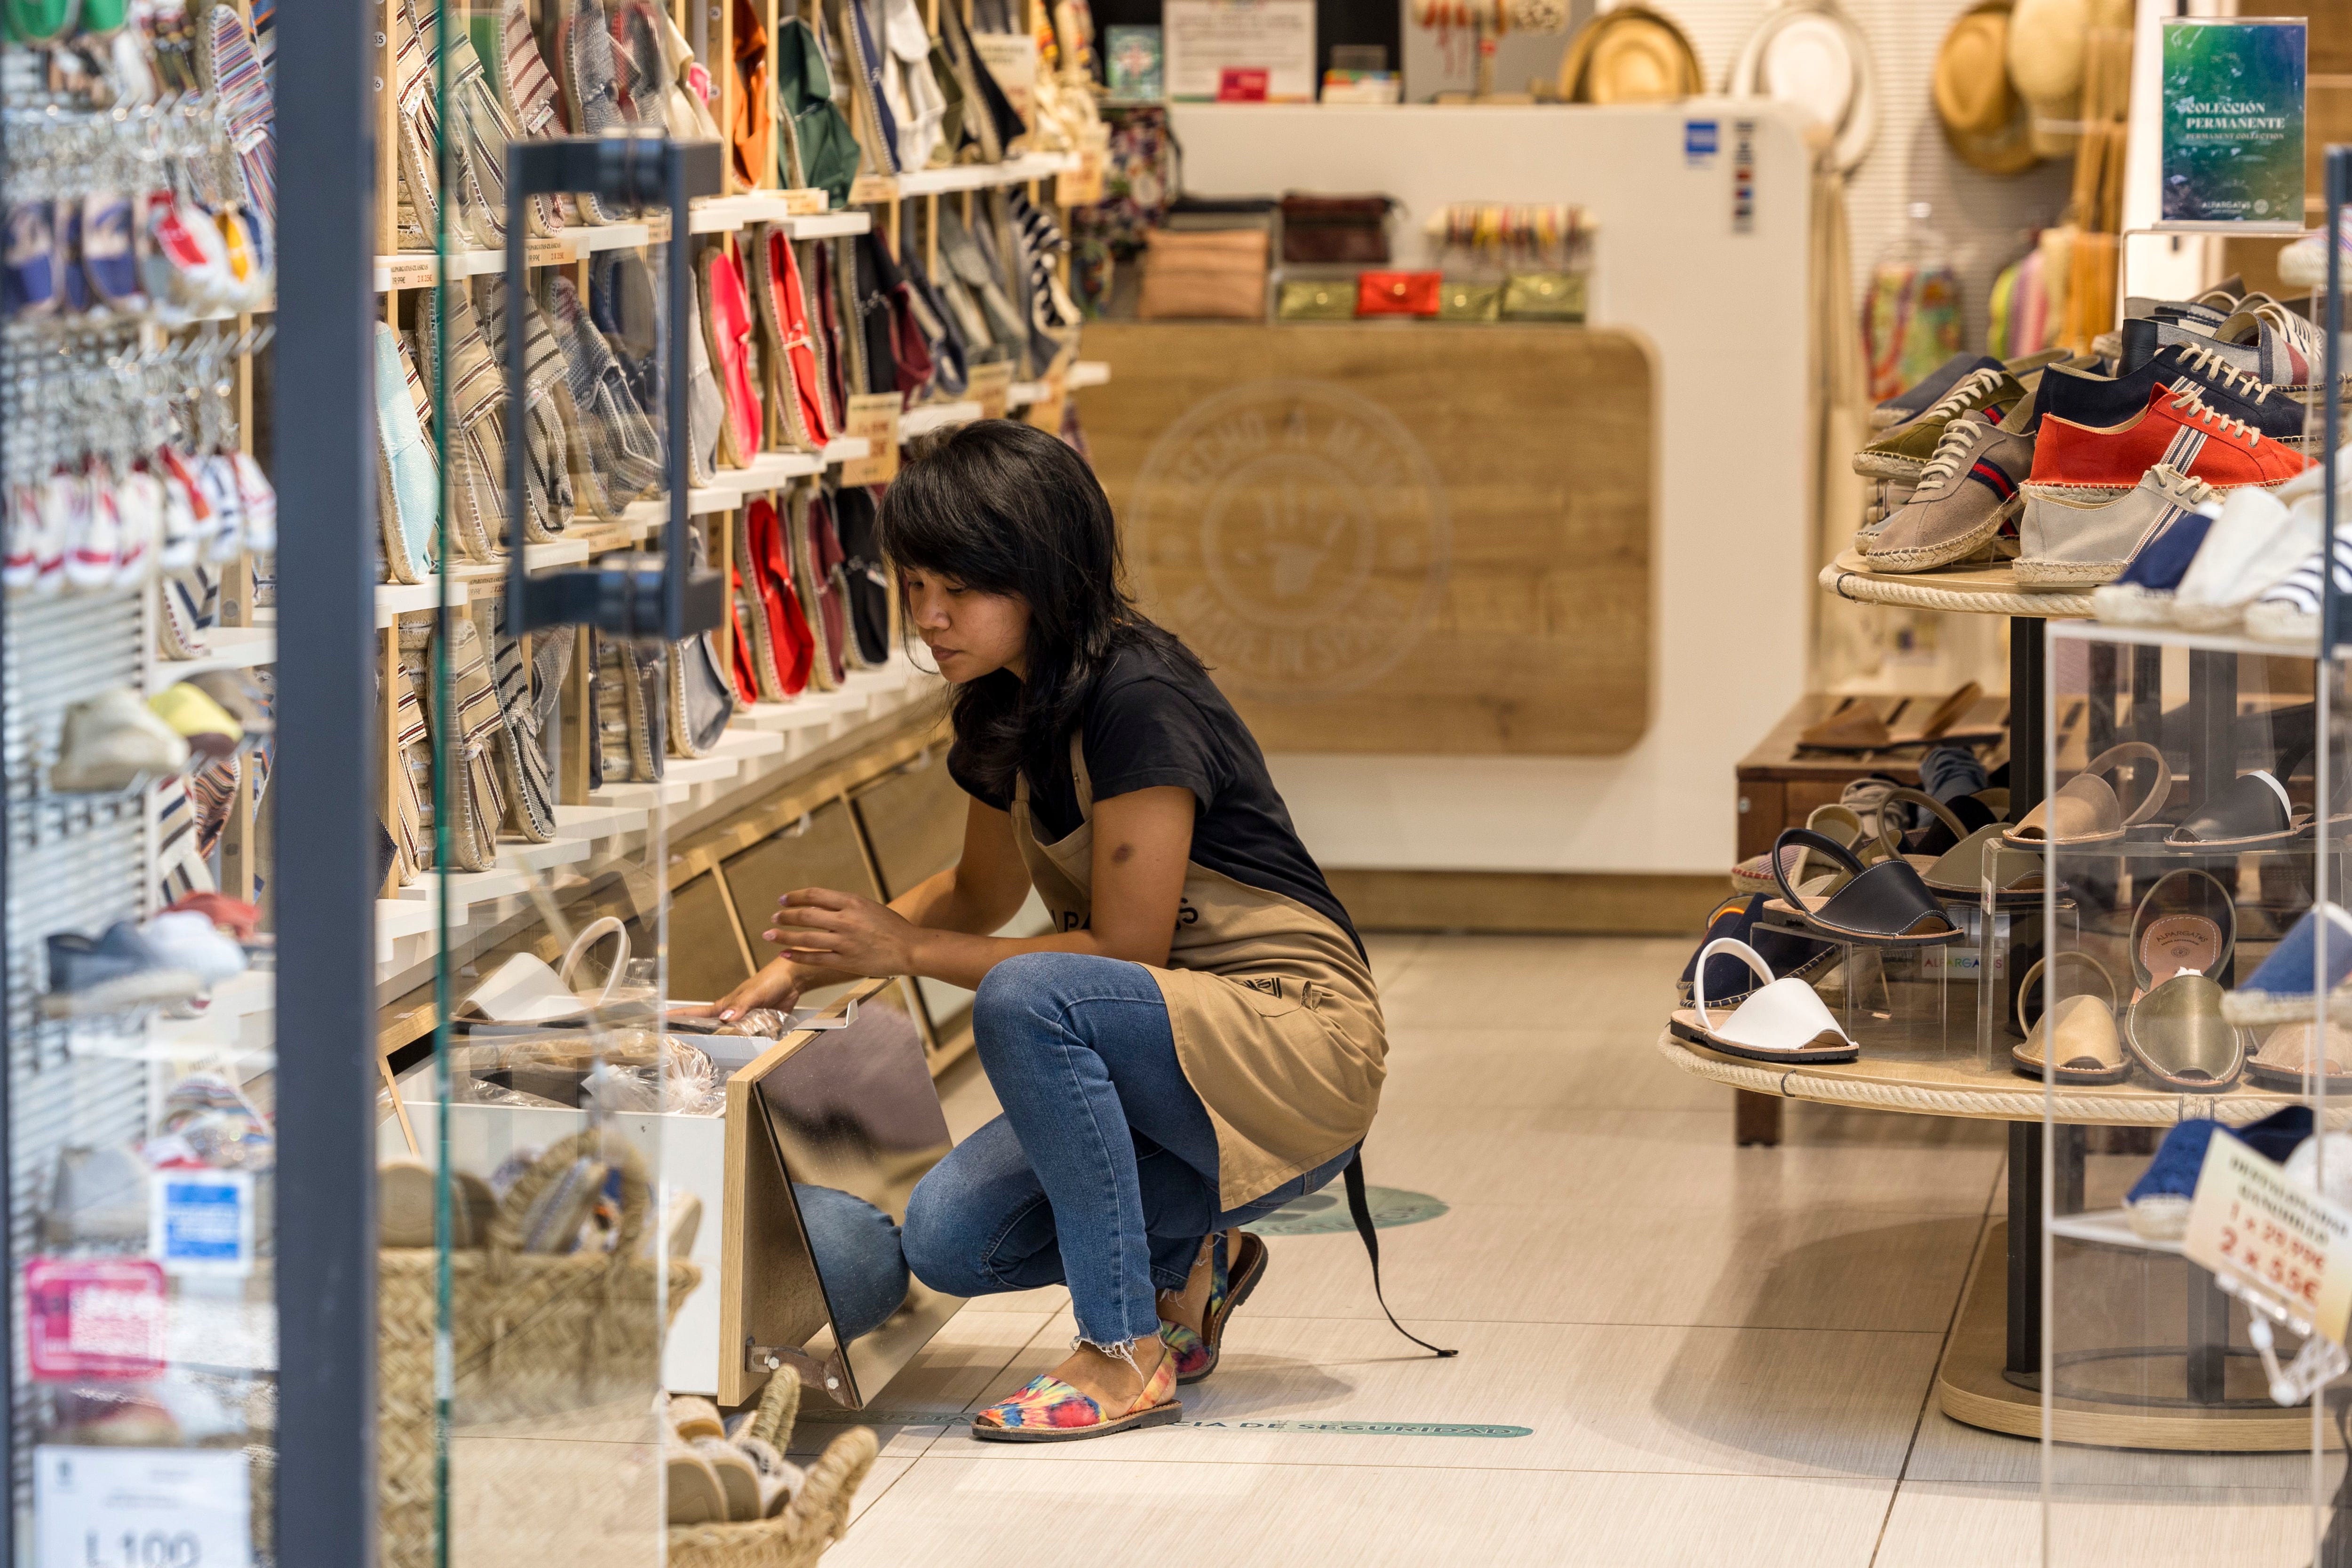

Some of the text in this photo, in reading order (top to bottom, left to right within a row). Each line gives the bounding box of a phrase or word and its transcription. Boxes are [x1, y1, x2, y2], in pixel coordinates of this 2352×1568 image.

[373, 35, 383, 44] 35
[2186, 100, 2265, 114] COLECCIÓN
[2186, 117, 2285, 129] PERMANENTE
[392, 276, 406, 285] 19,99€
[424, 274, 433, 282] 35€
[1924, 958, 2002, 968] ALPARGAS
[1297, 1424, 1512, 1435] SEGURIDAD
